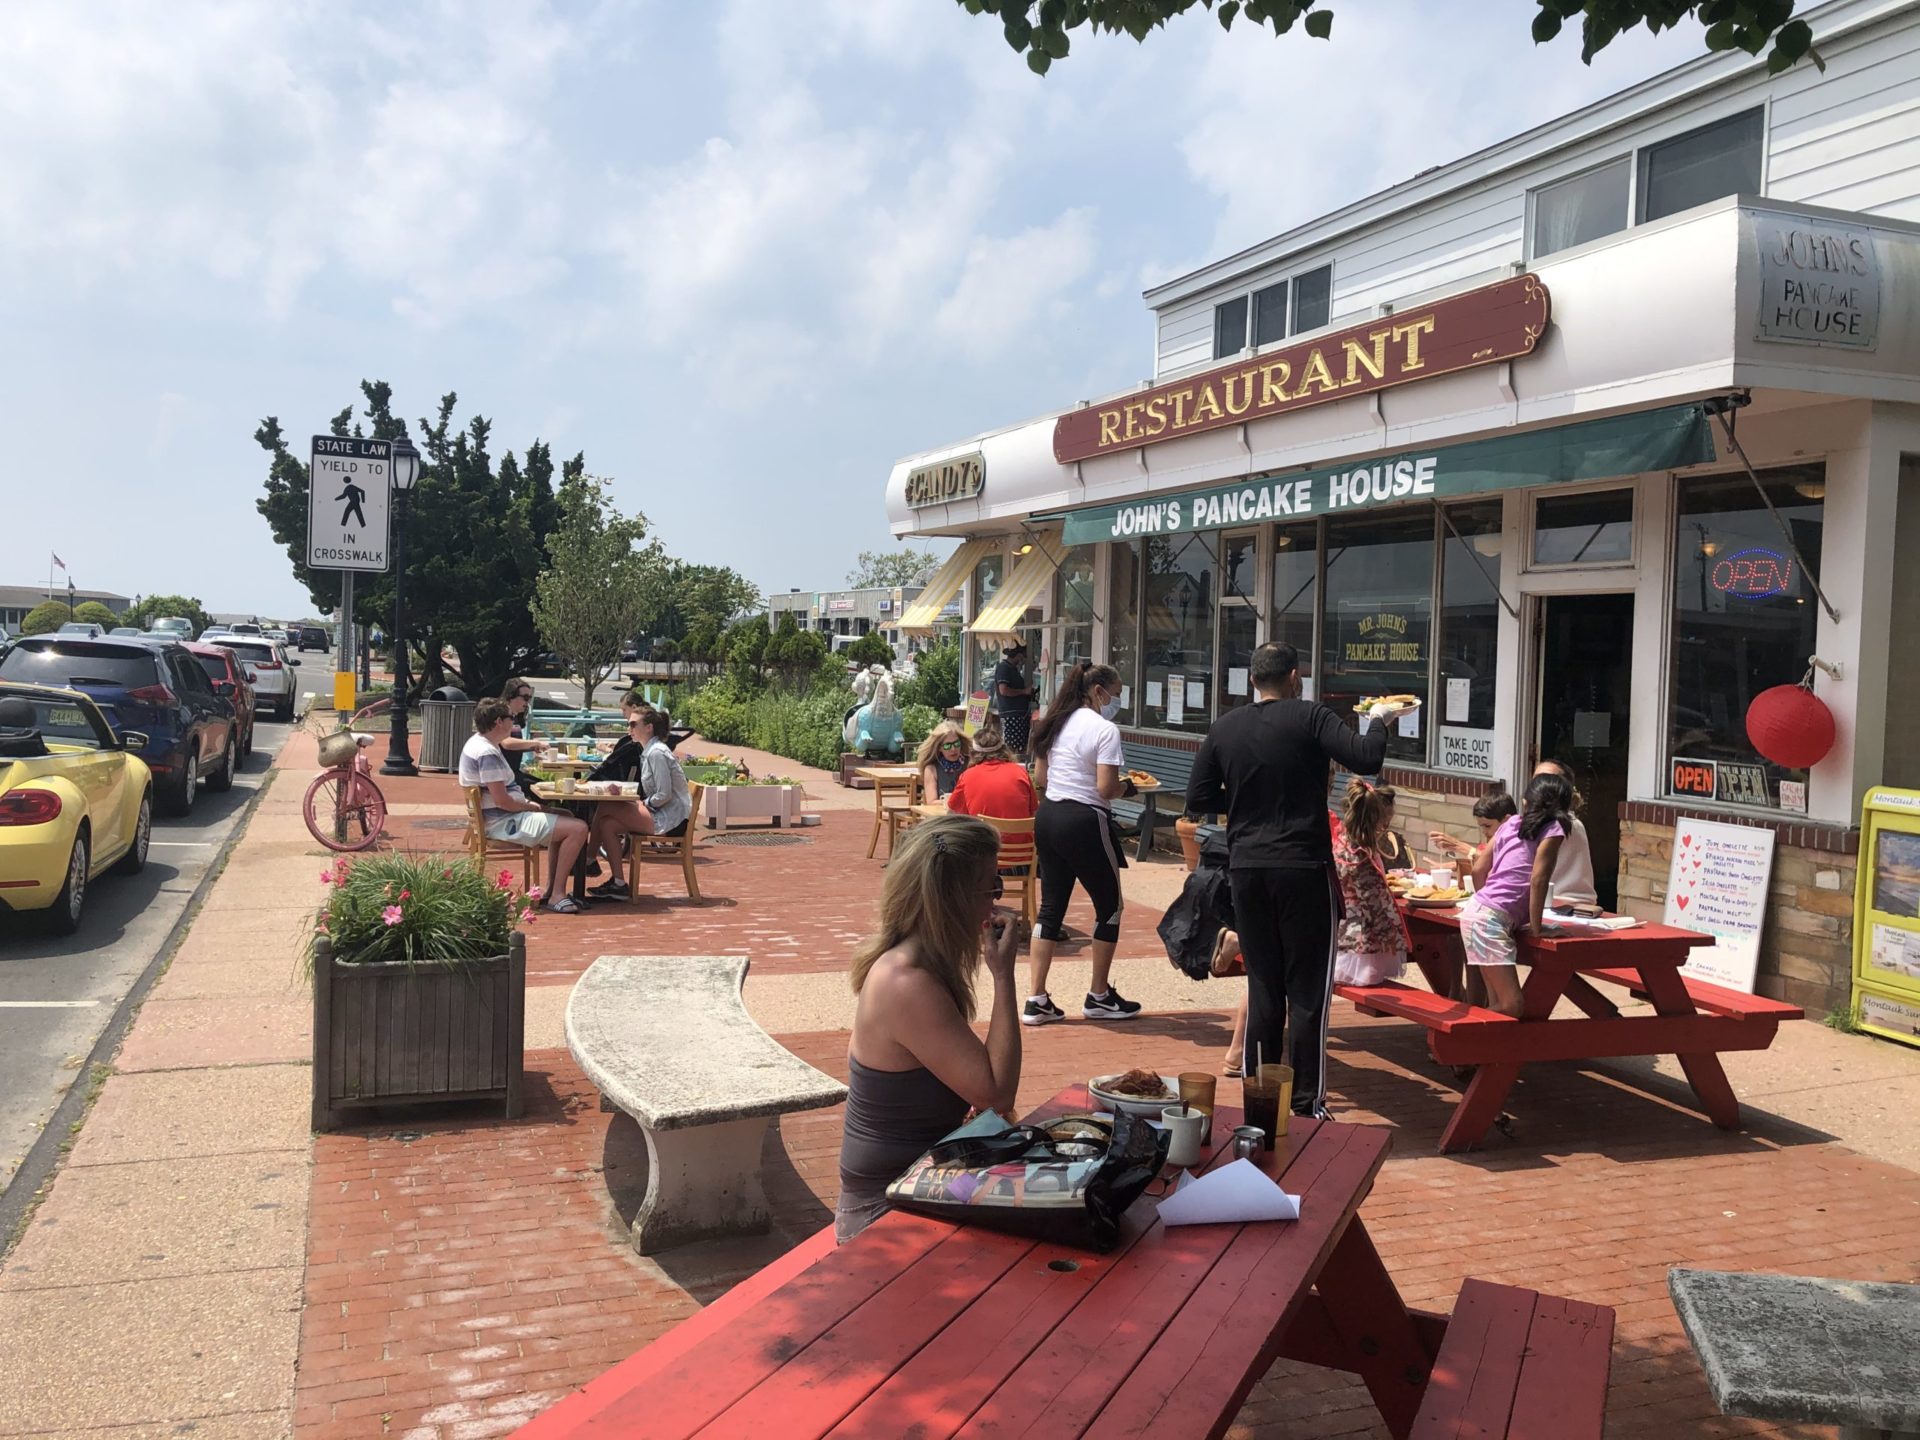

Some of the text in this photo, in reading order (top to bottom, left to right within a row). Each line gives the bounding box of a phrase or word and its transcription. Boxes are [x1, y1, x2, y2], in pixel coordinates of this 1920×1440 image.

[1775, 307, 1862, 336] HOUSE
[1097, 313, 1436, 447] RESTAURANT
[317, 440, 387, 456] STATE LAW
[320, 460, 383, 475] YIELD TO
[1111, 457, 1438, 537] JOHN'S PANCAKE HOUSE
[343, 533, 356, 544] IN
[314, 548, 383, 562] CROSSWALK
[1712, 559, 1792, 591] OPEN
[1376, 613, 1408, 634] JOHN'S
[1345, 643, 1420, 661] PANCAKE HOUSE
[1443, 736, 1492, 753] TAKE OUT
[1445, 752, 1489, 770] ORDERS
[1675, 765, 1713, 792] OPEN
[1781, 782, 1803, 794] CASH
[1782, 793, 1804, 805] ONLY
[1875, 793, 1914, 805] Montauk
[1863, 997, 1903, 1014] Montauk
